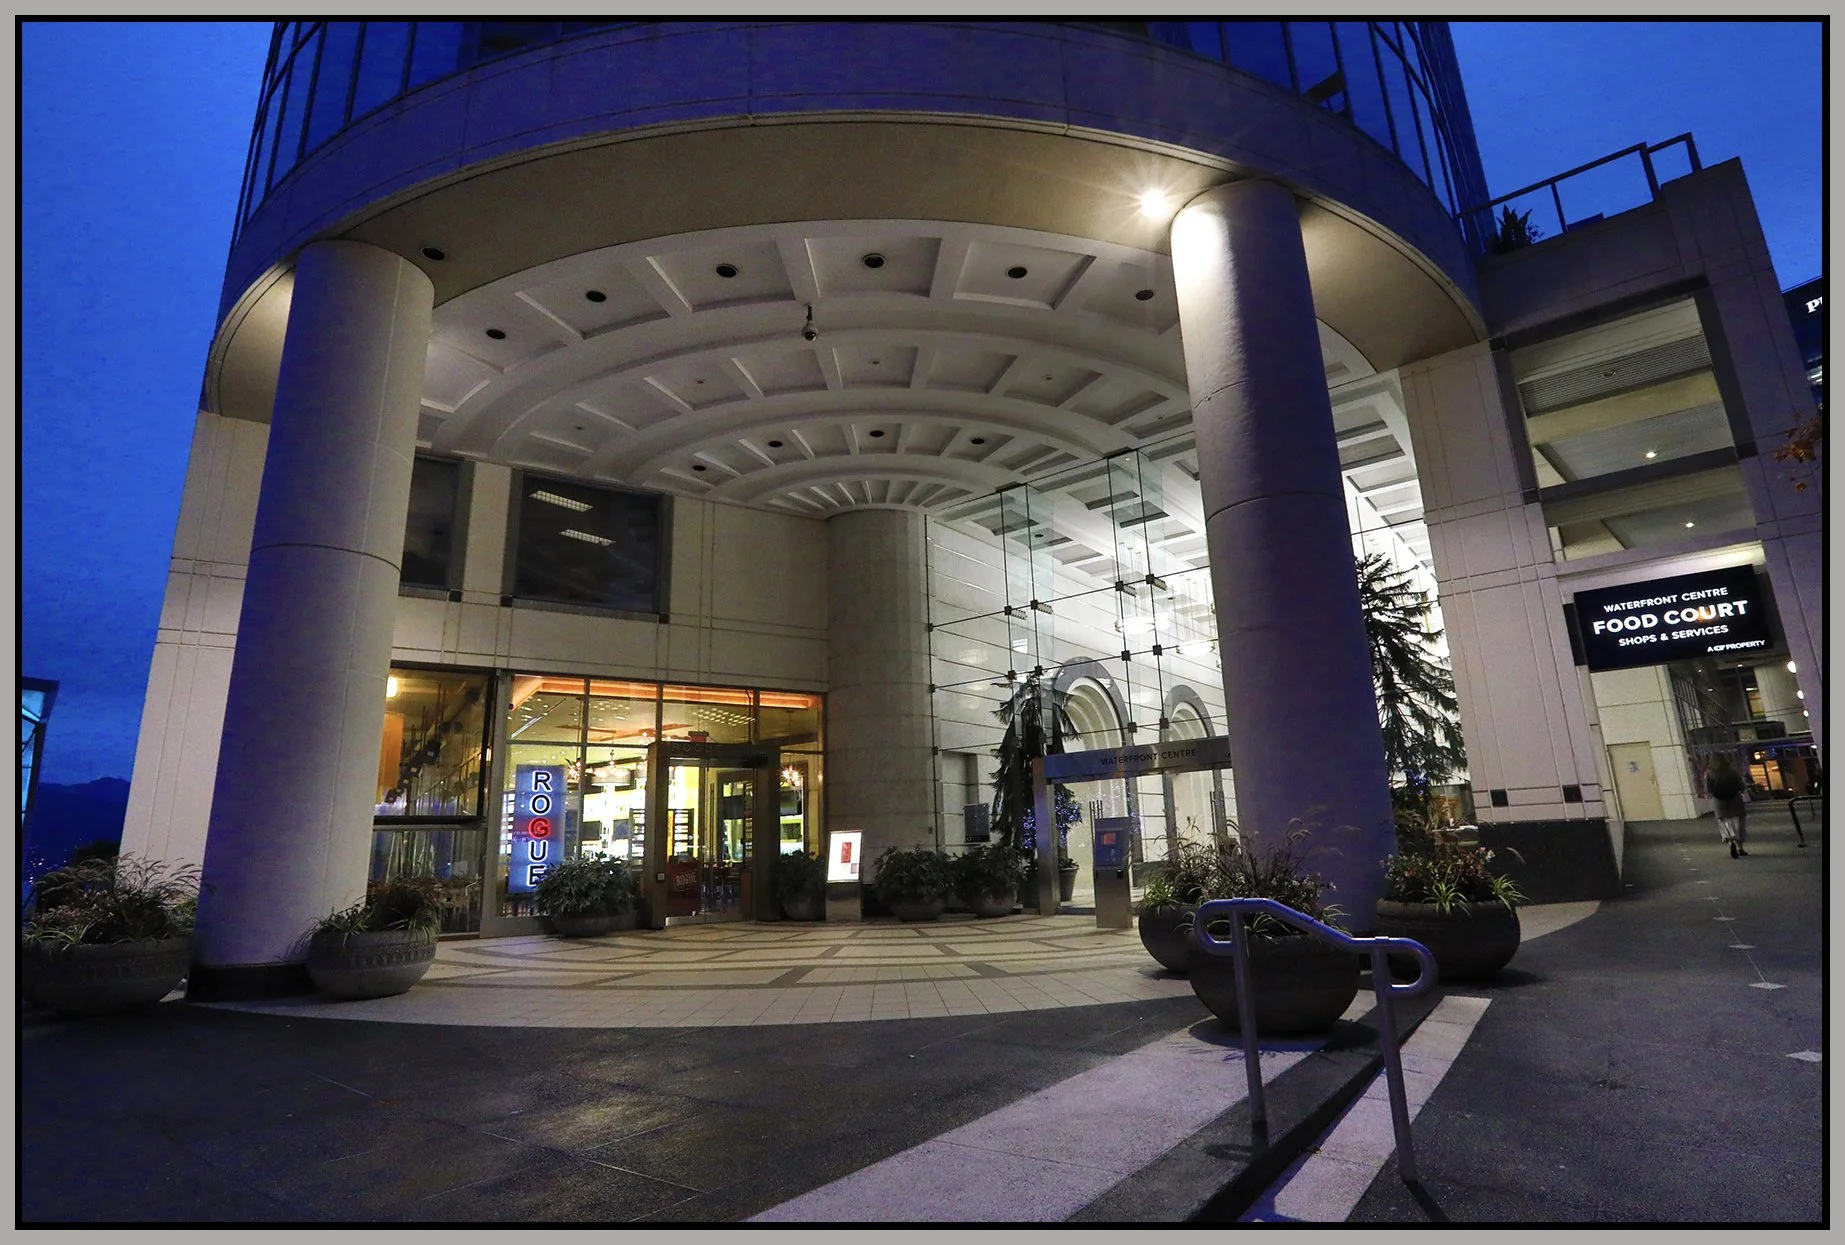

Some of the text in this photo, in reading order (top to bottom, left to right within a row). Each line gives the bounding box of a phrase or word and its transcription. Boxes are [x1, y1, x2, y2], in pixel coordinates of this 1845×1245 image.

[1603, 586, 1729, 613] WATERFRONT CENTRE
[1592, 599, 1748, 635] FOOD COURT
[1618, 624, 1730, 647] SHOPS & SERVICES
[1725, 639, 1766, 650] PROPERTY
[1100, 748, 1197, 766] WATERFRONT CENTRE
[526, 770, 553, 887] ROGUE
